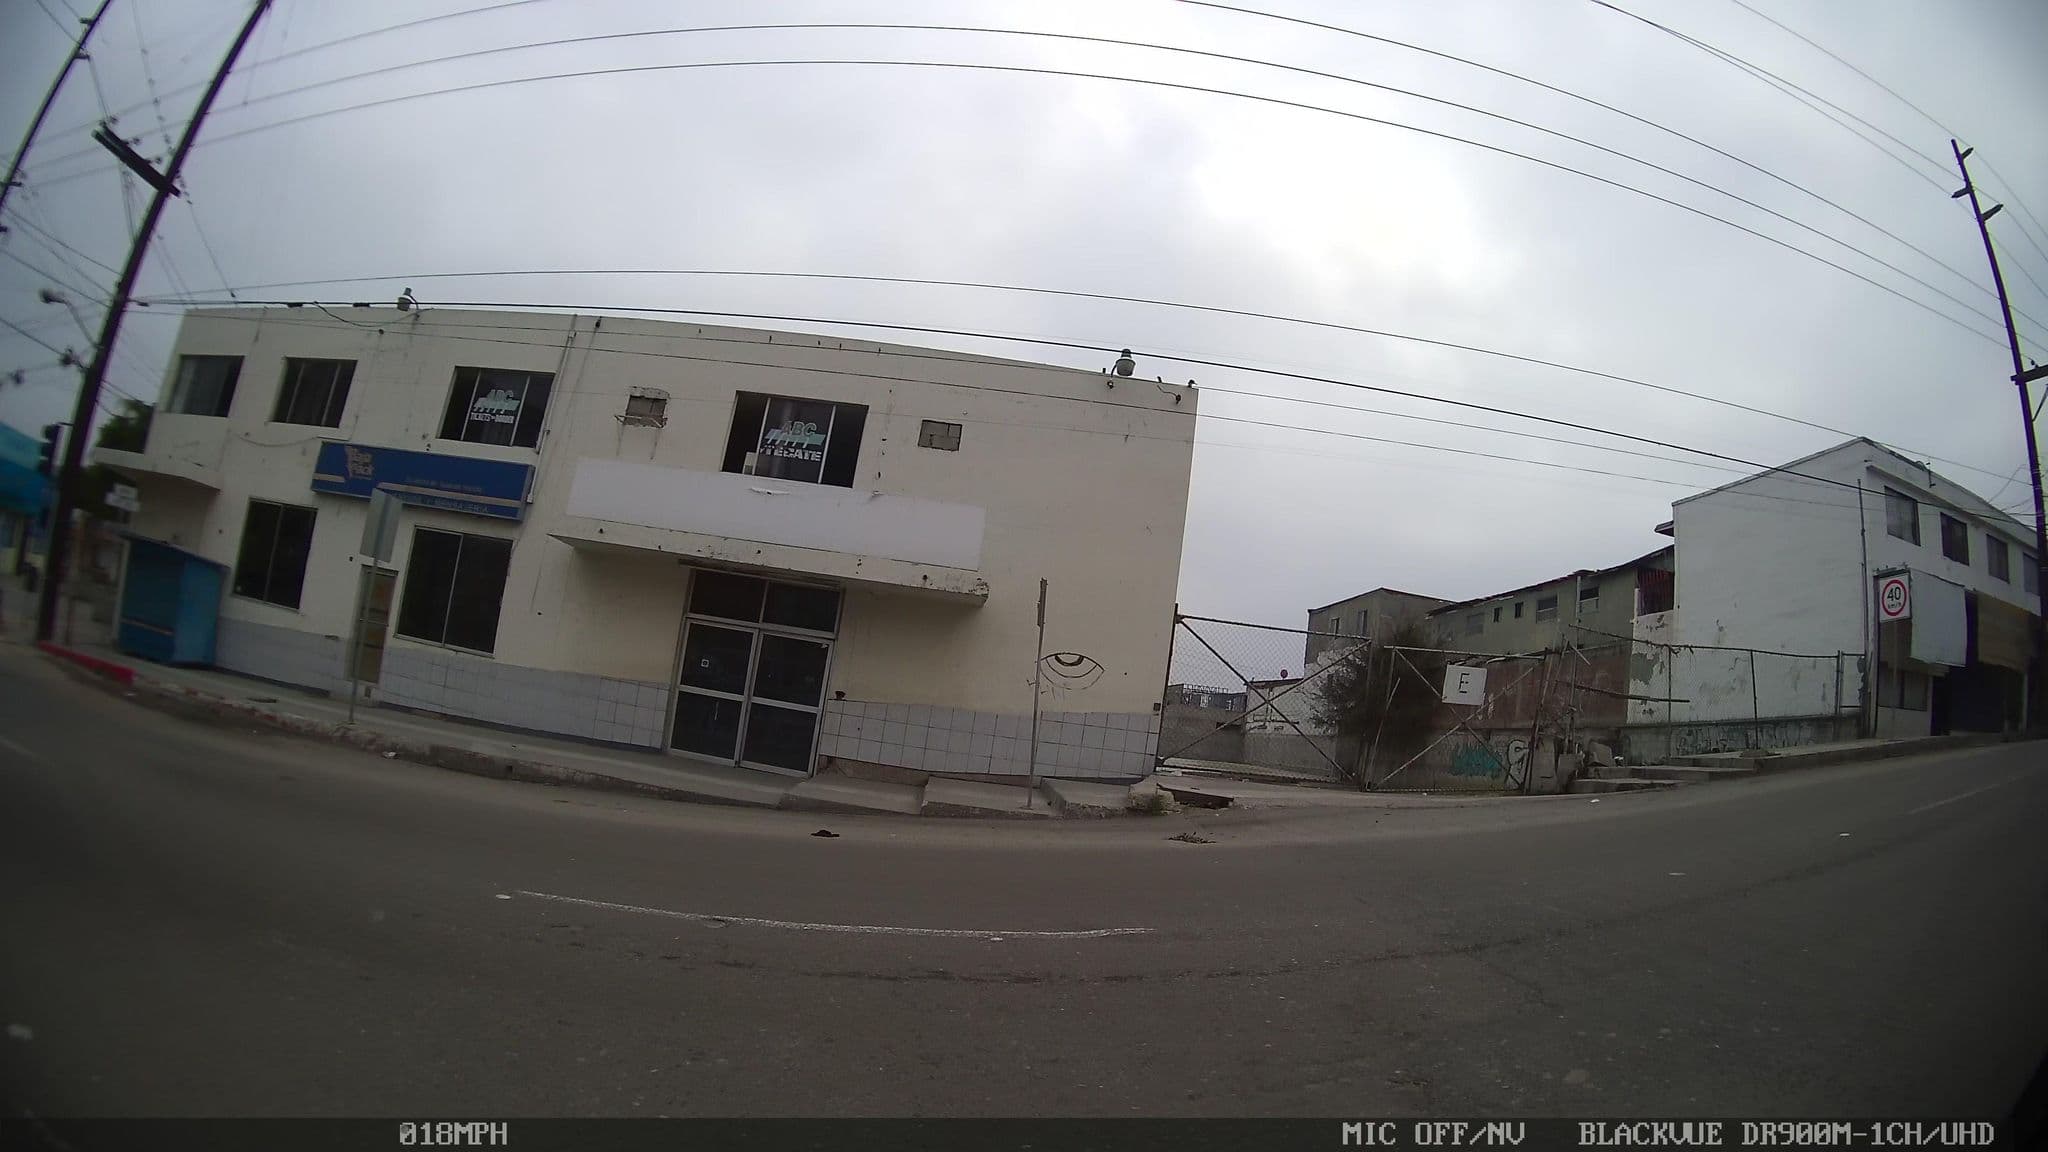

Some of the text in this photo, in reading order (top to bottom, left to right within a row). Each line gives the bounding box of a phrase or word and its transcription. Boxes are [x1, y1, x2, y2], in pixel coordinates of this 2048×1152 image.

[781, 421, 817, 437] ABC
[1887, 586, 1902, 601] 40
[1459, 672, 1470, 694] E
